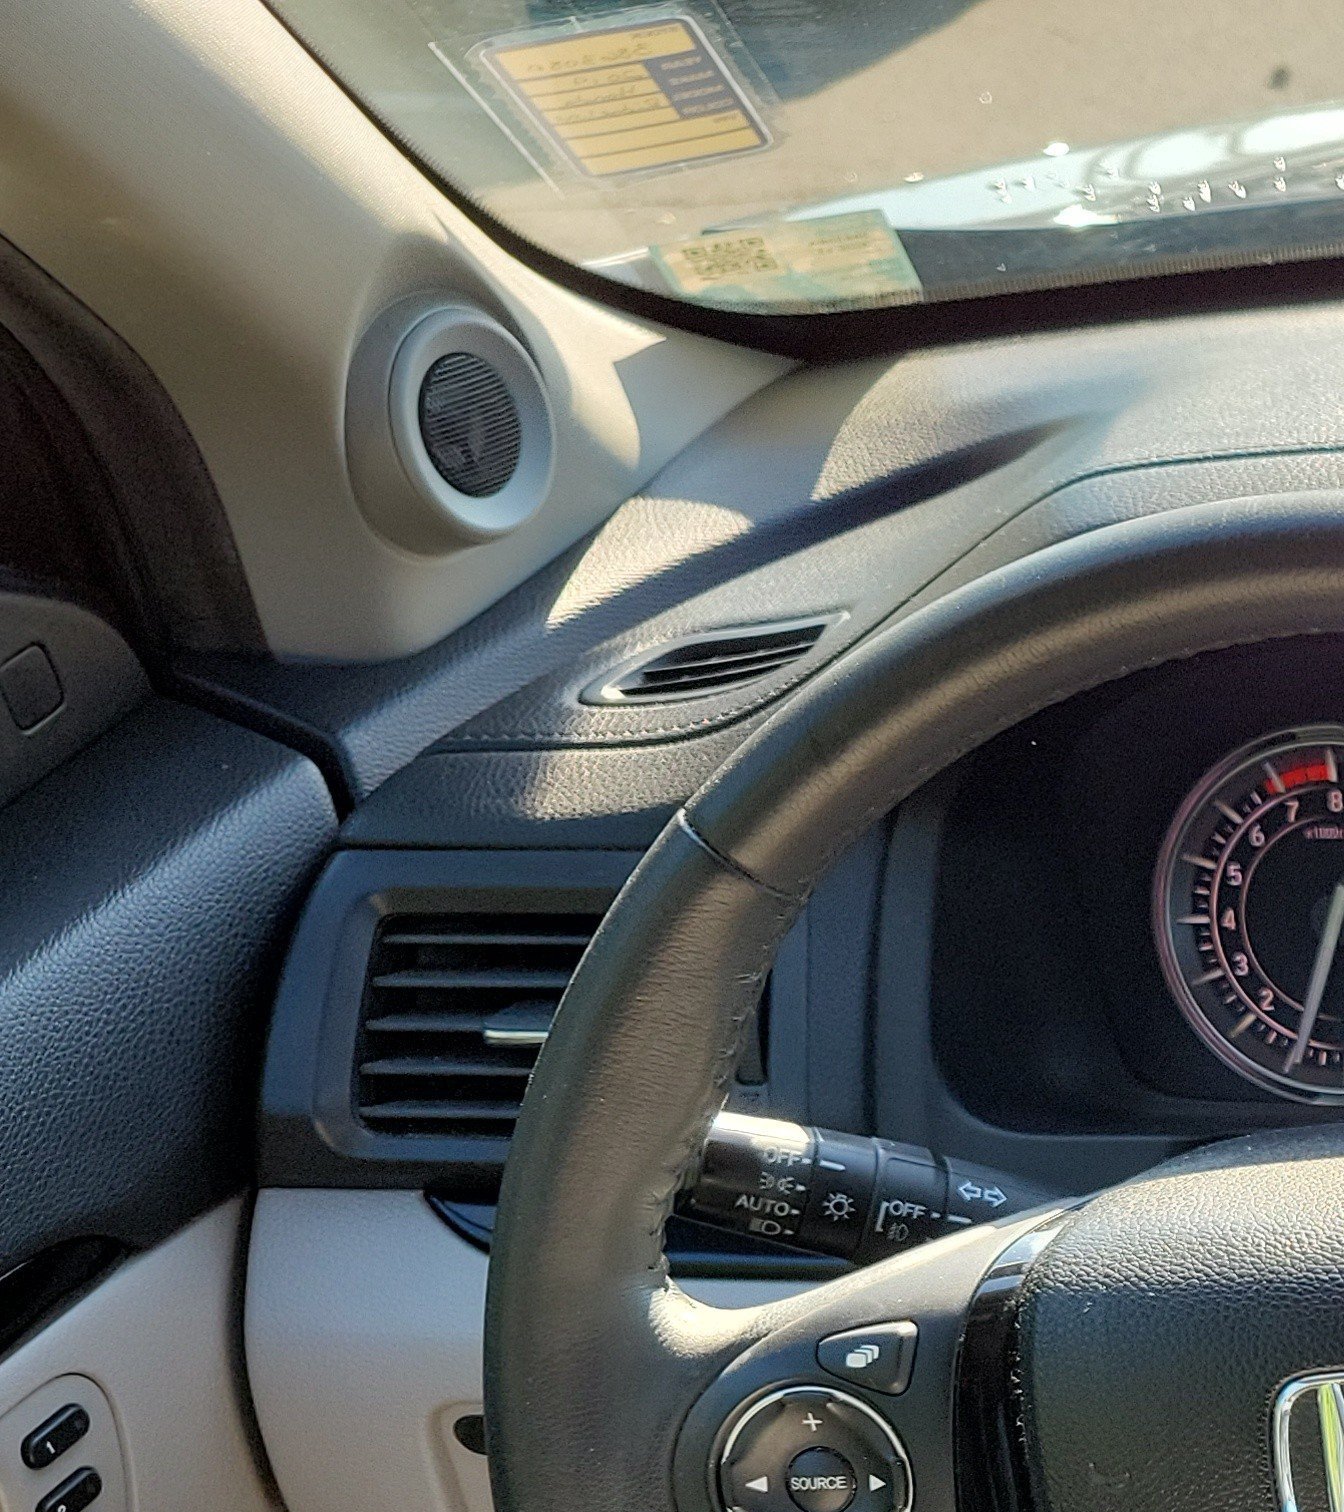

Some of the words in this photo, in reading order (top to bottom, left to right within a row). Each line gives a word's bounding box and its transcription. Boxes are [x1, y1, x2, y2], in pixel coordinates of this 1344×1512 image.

[1284, 801, 1299, 823] 7
[1327, 789, 1344, 813] 8
[1250, 825, 1266, 847] 6
[1226, 861, 1243, 886] 5
[1221, 907, 1236, 930] 4
[1233, 952, 1249, 976] 3
[1258, 987, 1275, 1011] 2
[763, 1147, 801, 1167] OFF
[735, 1194, 790, 1217] AUTO
[889, 1200, 927, 1219] OFF
[47, 1441, 55, 1453] 1
[791, 1476, 847, 1490] SOURCE
